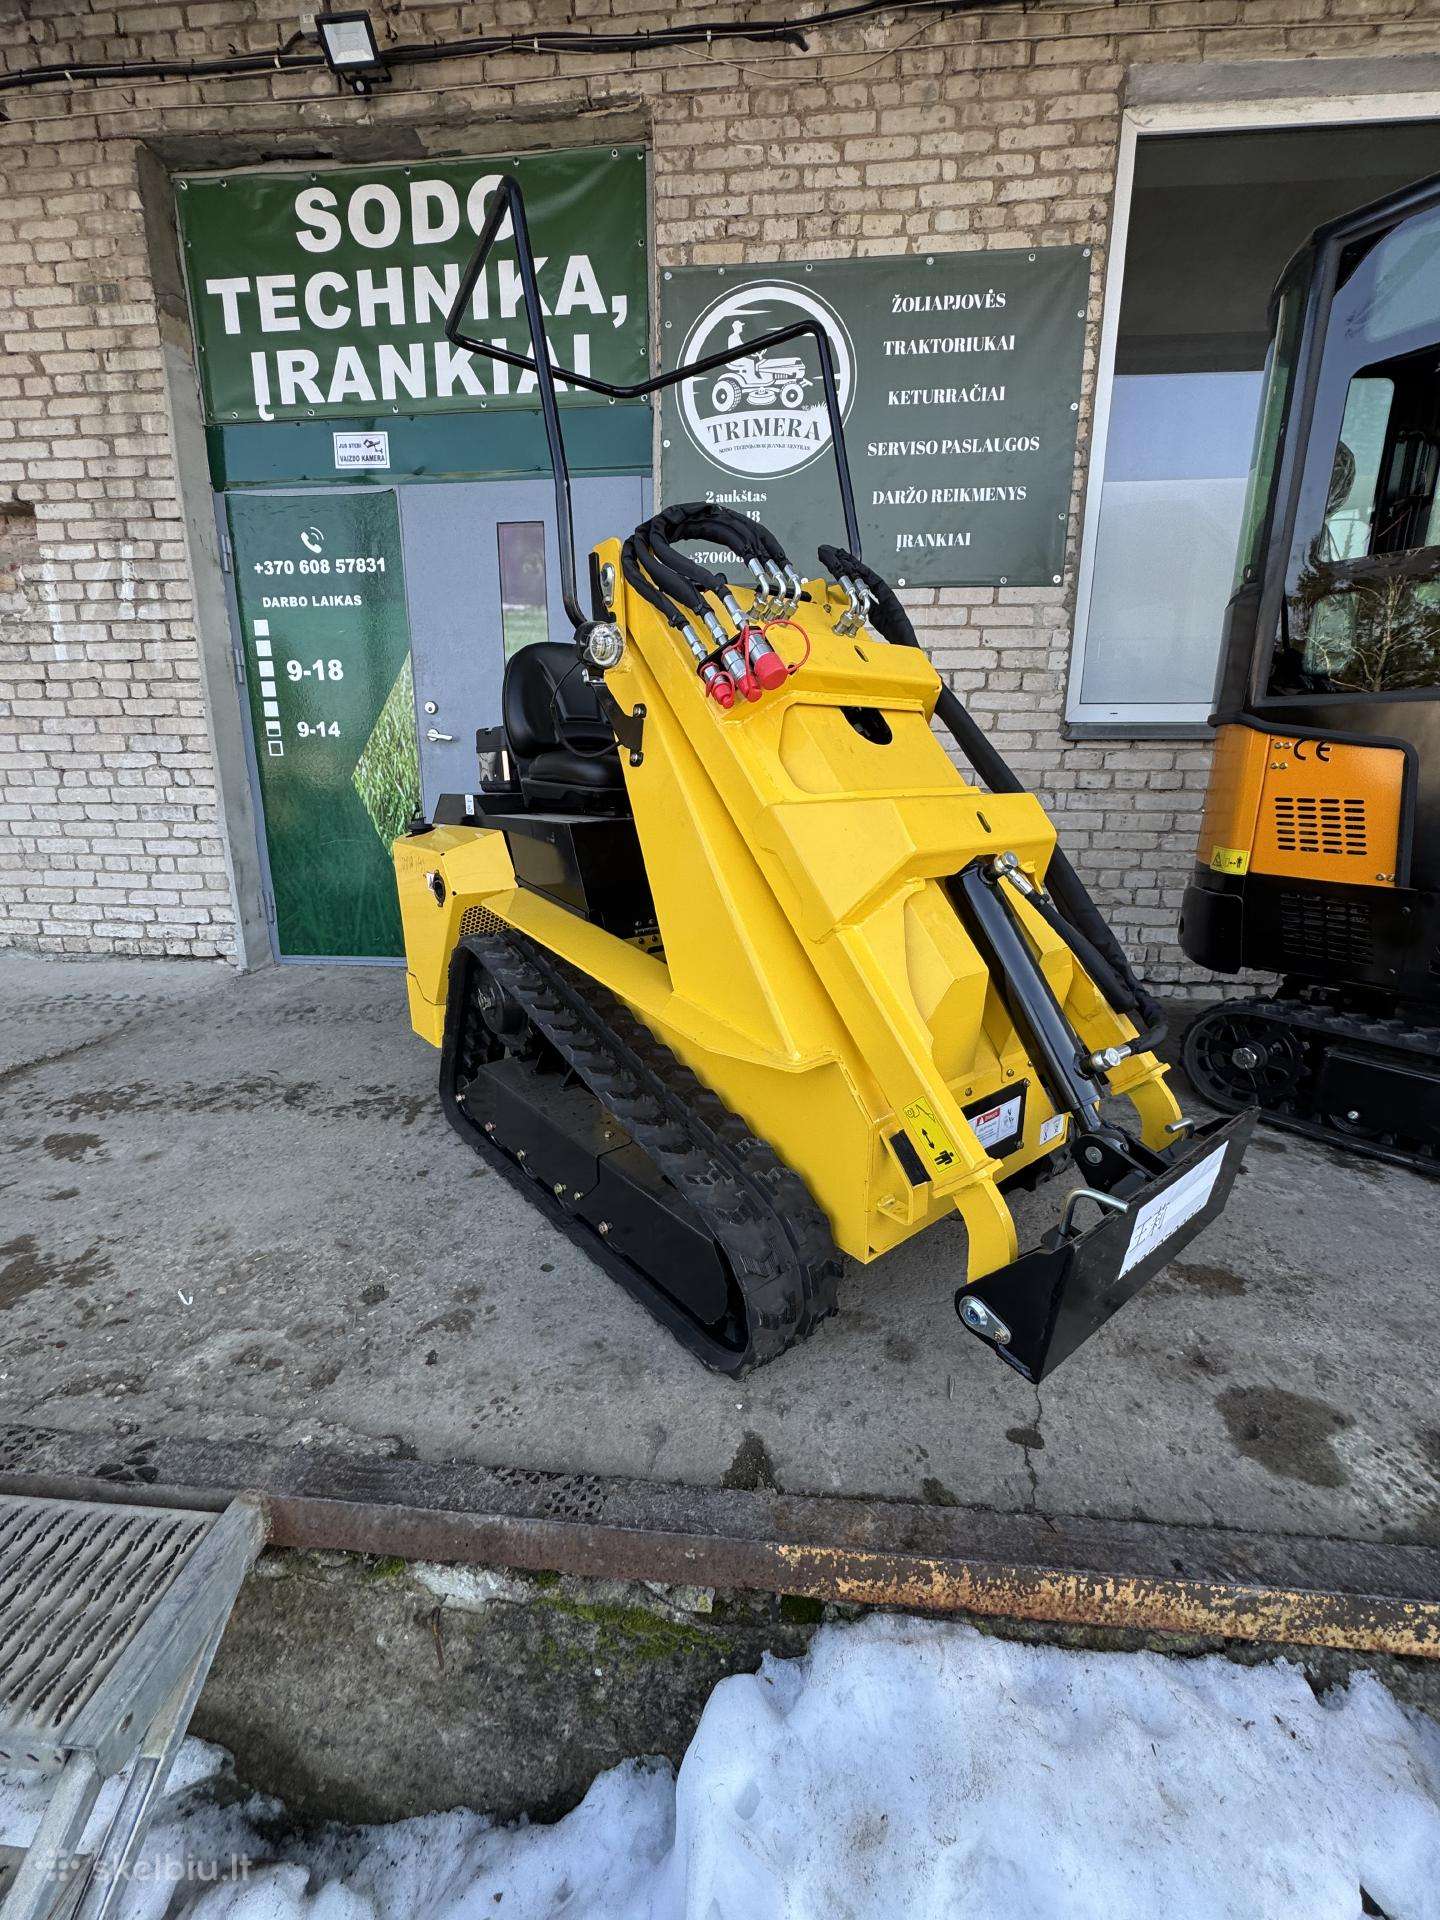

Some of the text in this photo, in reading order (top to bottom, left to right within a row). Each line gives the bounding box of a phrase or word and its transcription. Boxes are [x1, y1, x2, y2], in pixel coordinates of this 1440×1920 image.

[295, 174, 514, 253] SODO
[206, 254, 628, 334] TECHNIKA,
[891, 288, 1006, 313] ŽOLIAPJOVĖS
[883, 335, 1015, 356] TRAKTORIUKAI
[250, 333, 591, 421] ĮRANKIAI
[887, 384, 1006, 405] KETURRAČIAI
[707, 417, 822, 443] TRIMERA
[867, 436, 1040, 456] SERVISO PASLAUGOS
[705, 490, 767, 503] 2 aukštas
[872, 486, 1027, 505] DARŽO REIKMENYS
[896, 532, 971, 552] ĮRANKIAI
[253, 557, 386, 575] +370 608 57831
[262, 595, 362, 608] DARBO LAIKAS
[286, 659, 344, 681] 9-18
[296, 721, 341, 738] 9-14
